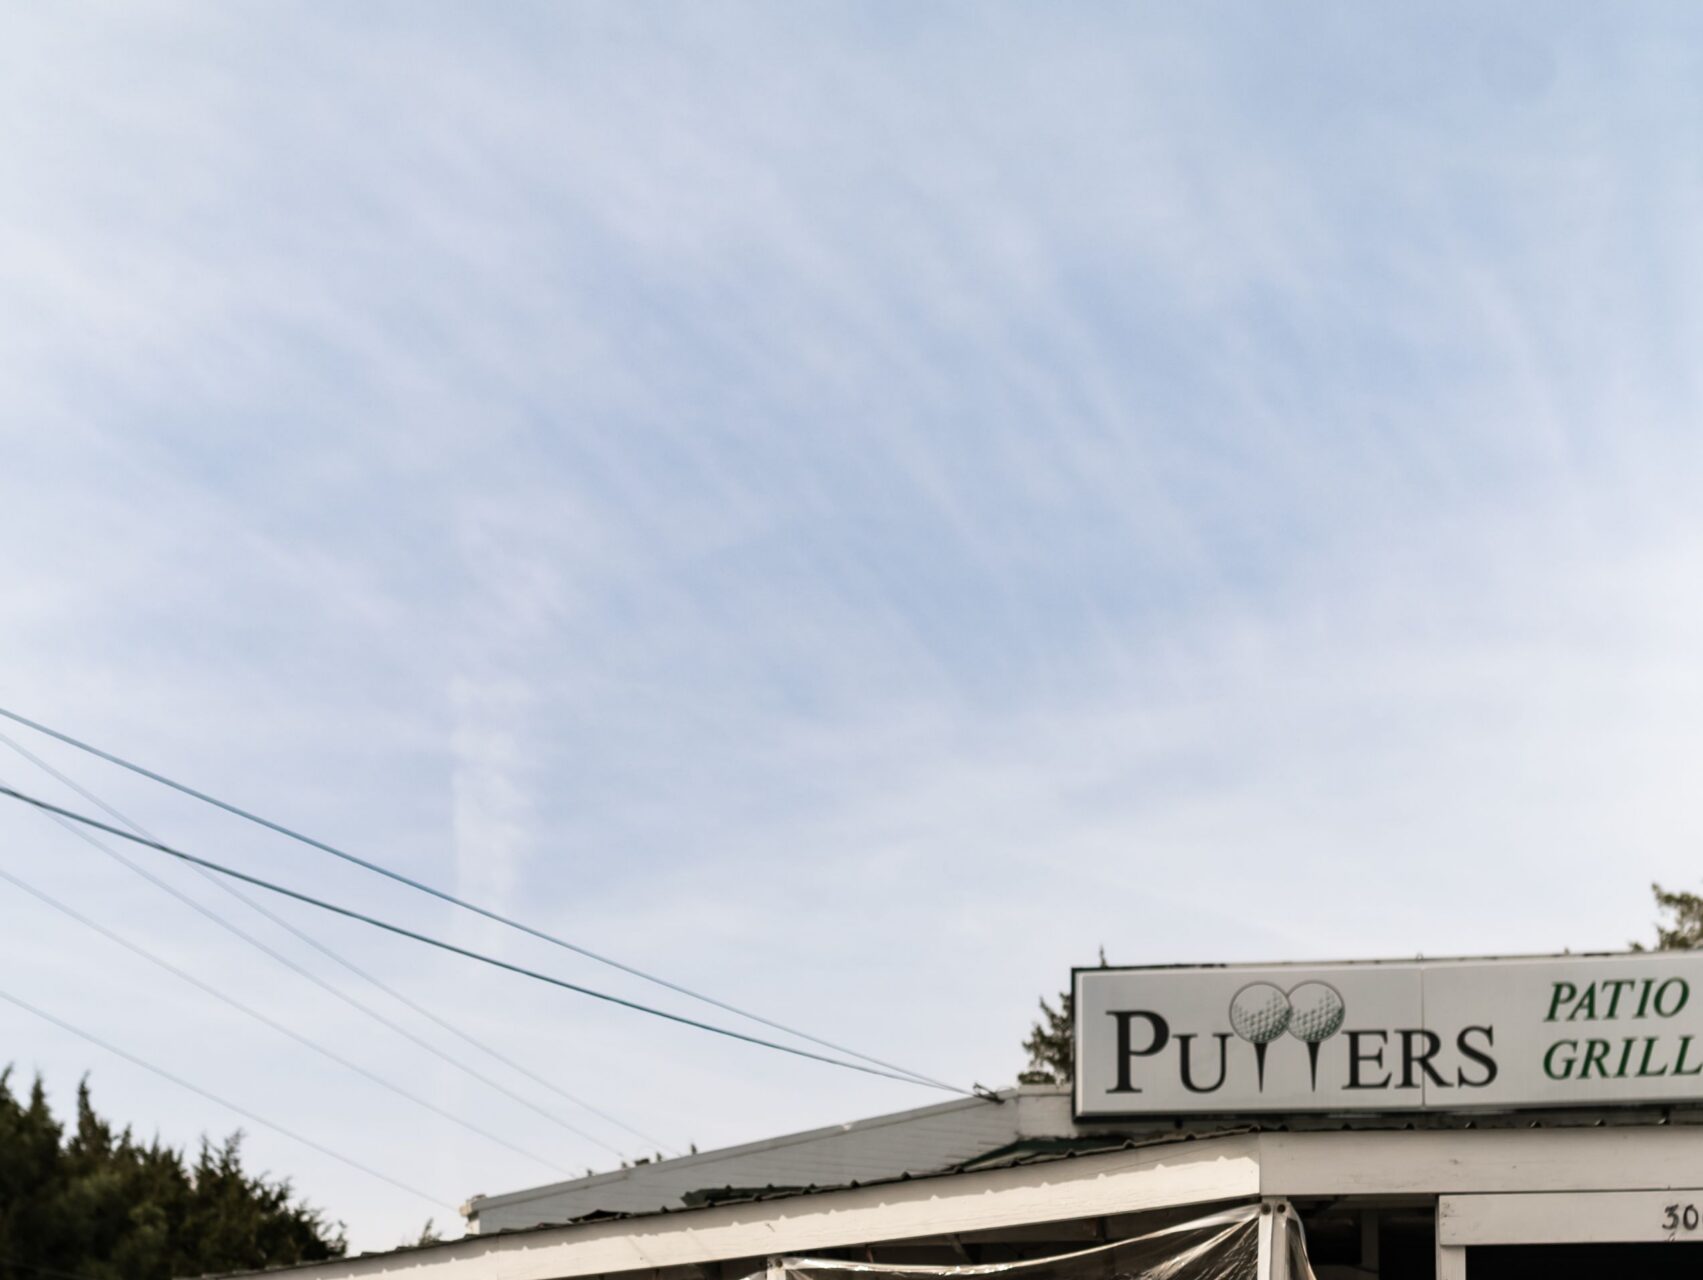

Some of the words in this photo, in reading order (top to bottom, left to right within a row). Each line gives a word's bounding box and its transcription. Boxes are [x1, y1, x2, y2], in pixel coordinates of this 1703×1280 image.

[1543, 977, 1690, 1022] PATIO
[1542, 1034, 1703, 1080] GRILL
[1662, 1203, 1703, 1231] 30
